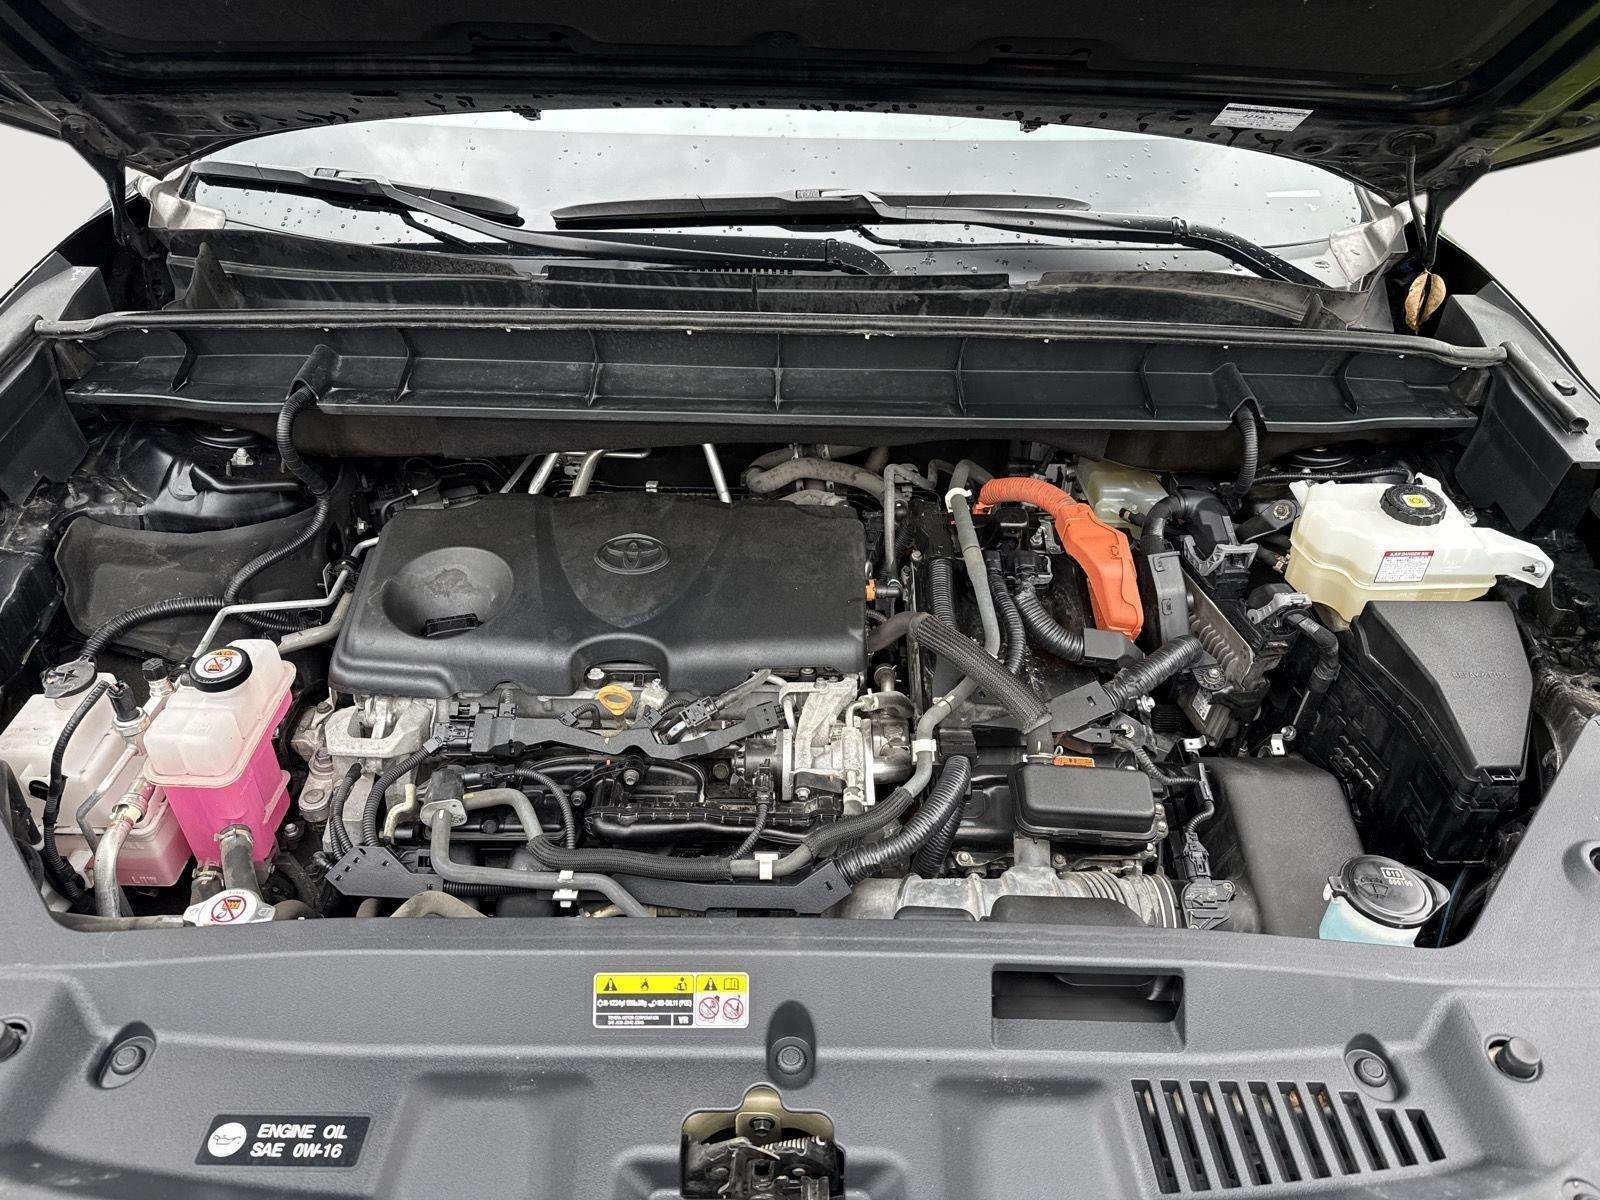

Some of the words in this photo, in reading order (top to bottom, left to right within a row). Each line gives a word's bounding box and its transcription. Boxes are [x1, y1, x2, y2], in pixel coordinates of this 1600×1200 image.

[257, 1123, 316, 1138] ENGINE
[322, 1125, 348, 1139] OIL
[250, 1142, 285, 1158] SAE
[292, 1143, 343, 1158] 0W-16
